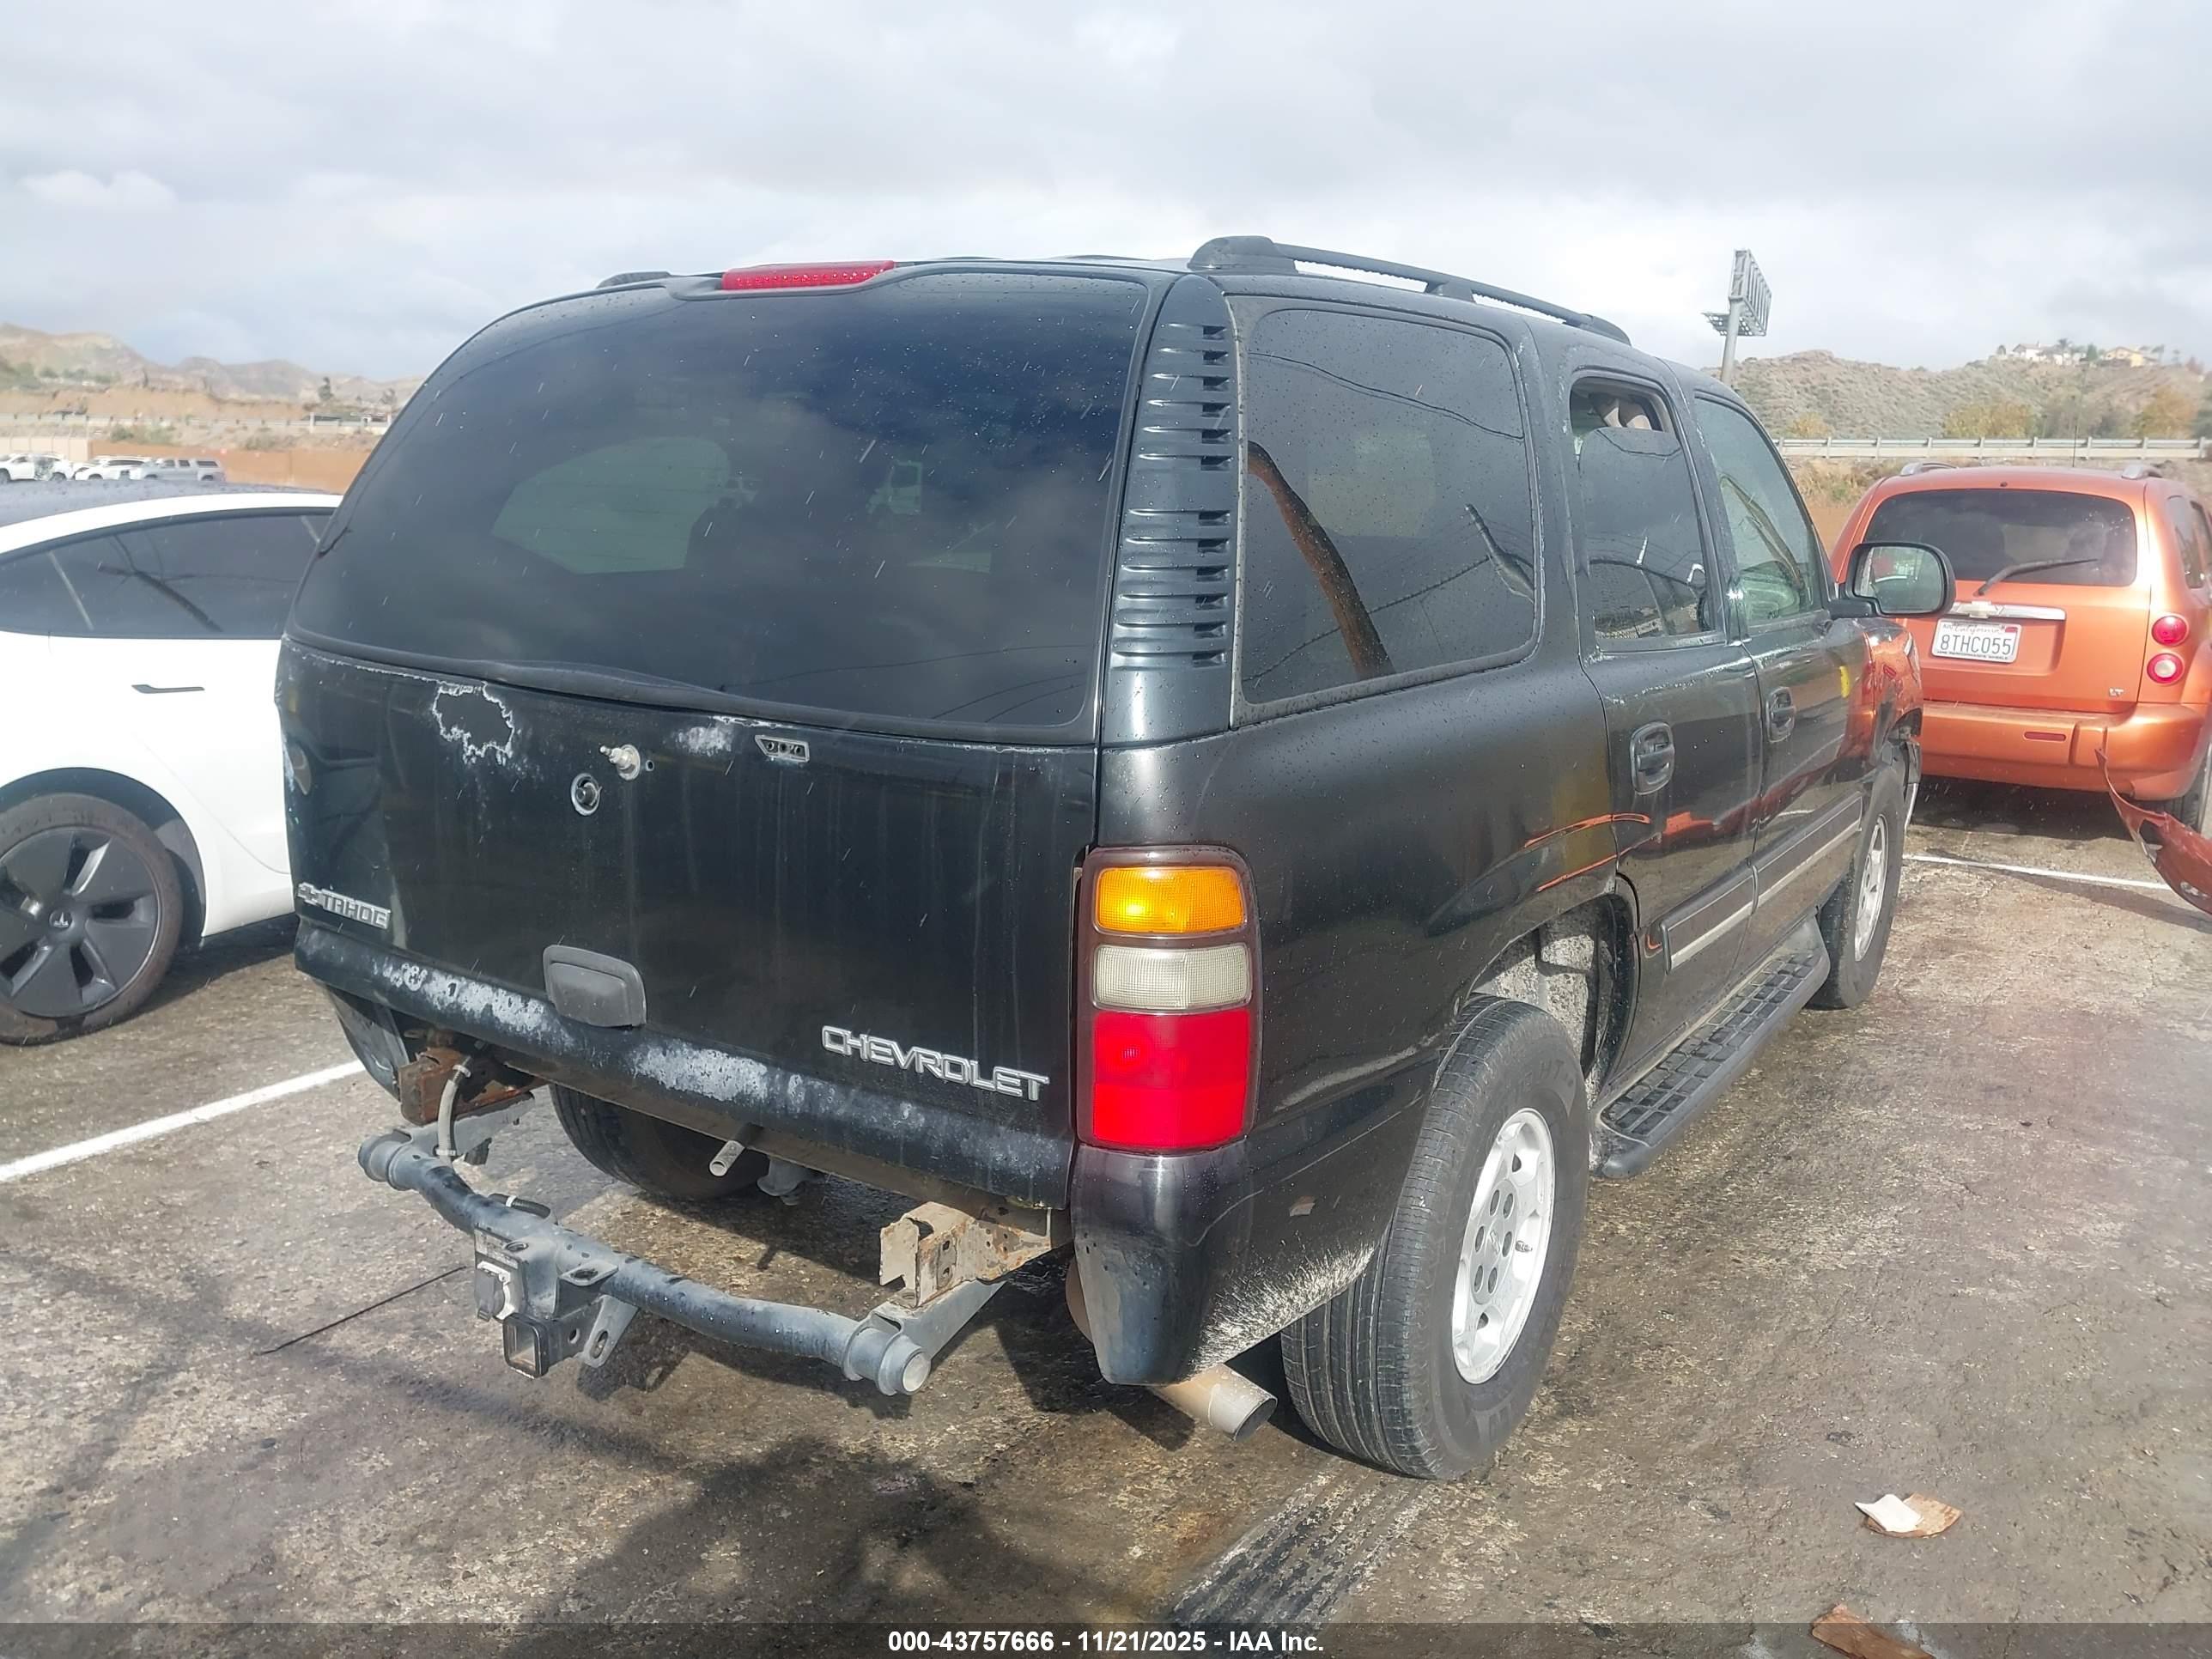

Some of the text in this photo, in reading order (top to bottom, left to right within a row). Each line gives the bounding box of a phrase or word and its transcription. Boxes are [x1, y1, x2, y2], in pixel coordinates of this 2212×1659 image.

[1940, 634, 2012, 656] 8THC055
[321, 888, 391, 929] TAHOE
[822, 1024, 1049, 1101] CHEVROLET
